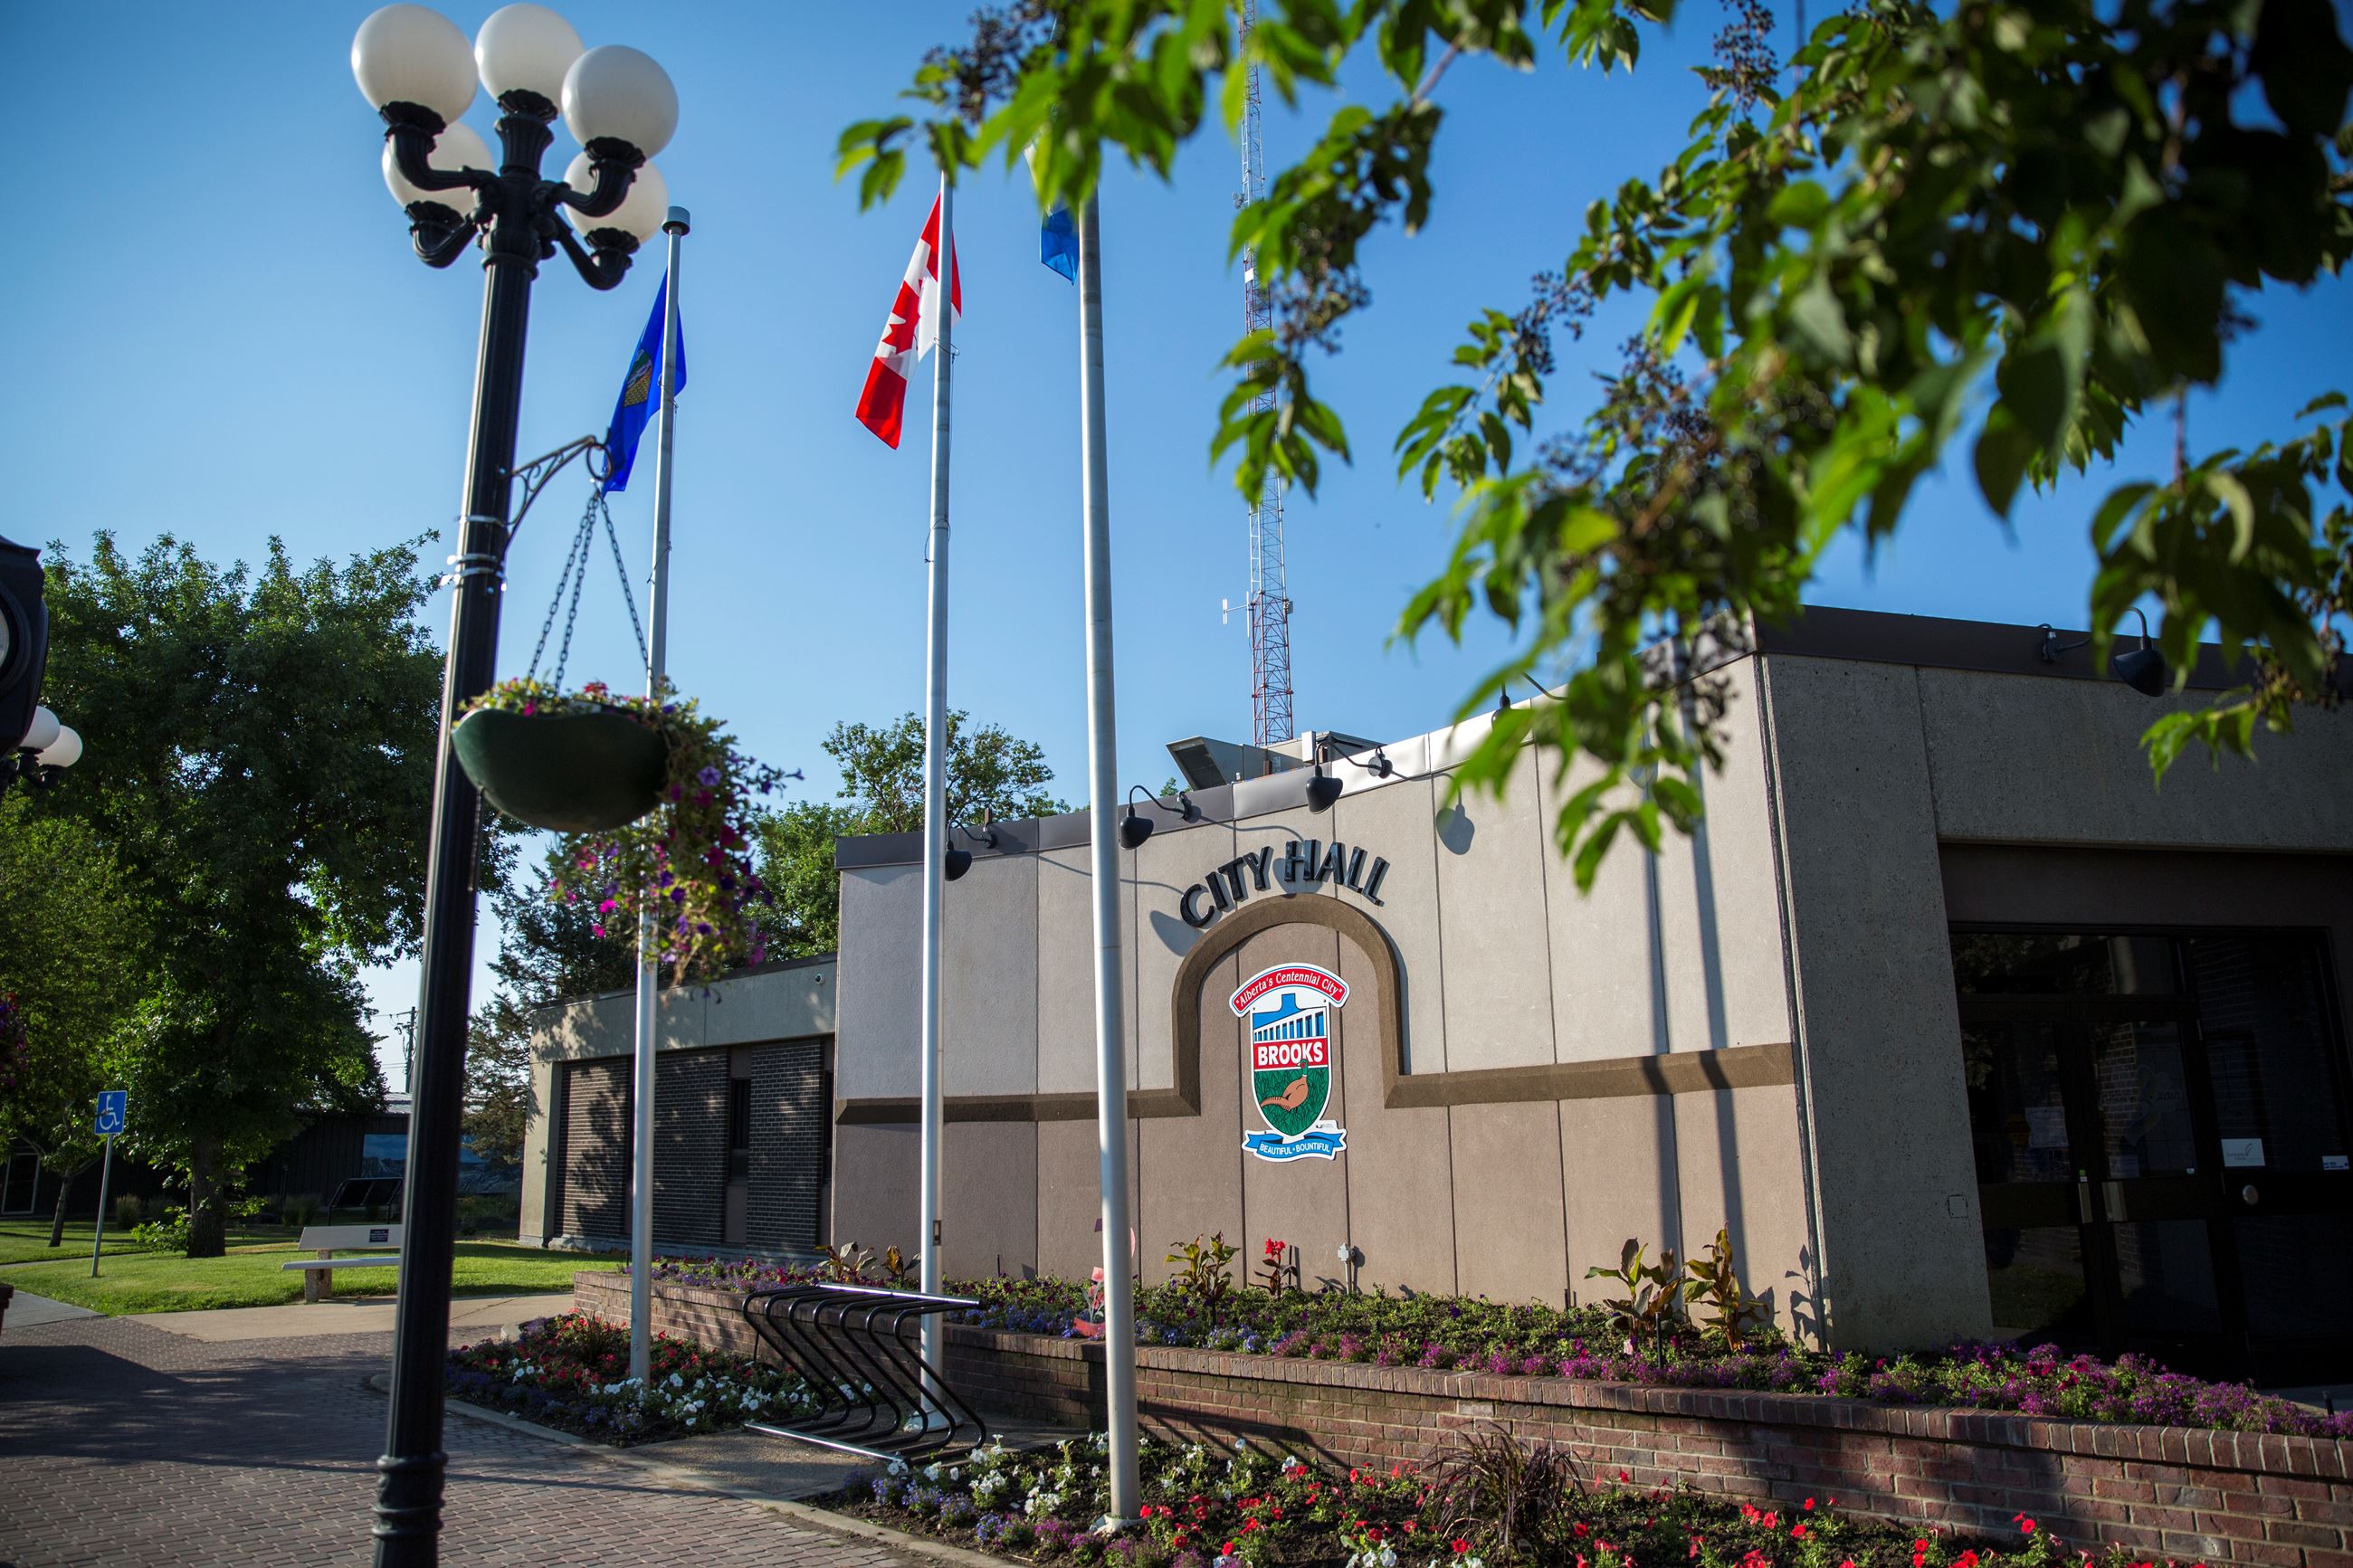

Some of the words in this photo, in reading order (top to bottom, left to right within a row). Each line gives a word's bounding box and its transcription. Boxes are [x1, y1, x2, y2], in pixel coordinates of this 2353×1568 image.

[1180, 846, 1273, 927] CITY
[1284, 840, 1390, 907] HALL
[1240, 978, 1274, 1007] Alberta's
[1275, 972, 1320, 986] Centennial
[1321, 978, 1338, 996] City
[1258, 1041, 1324, 1066] BROOKS
[1260, 1143, 1292, 1155] BEAUTIFUL
[1295, 1142, 1330, 1153] BOUNTIFUL
